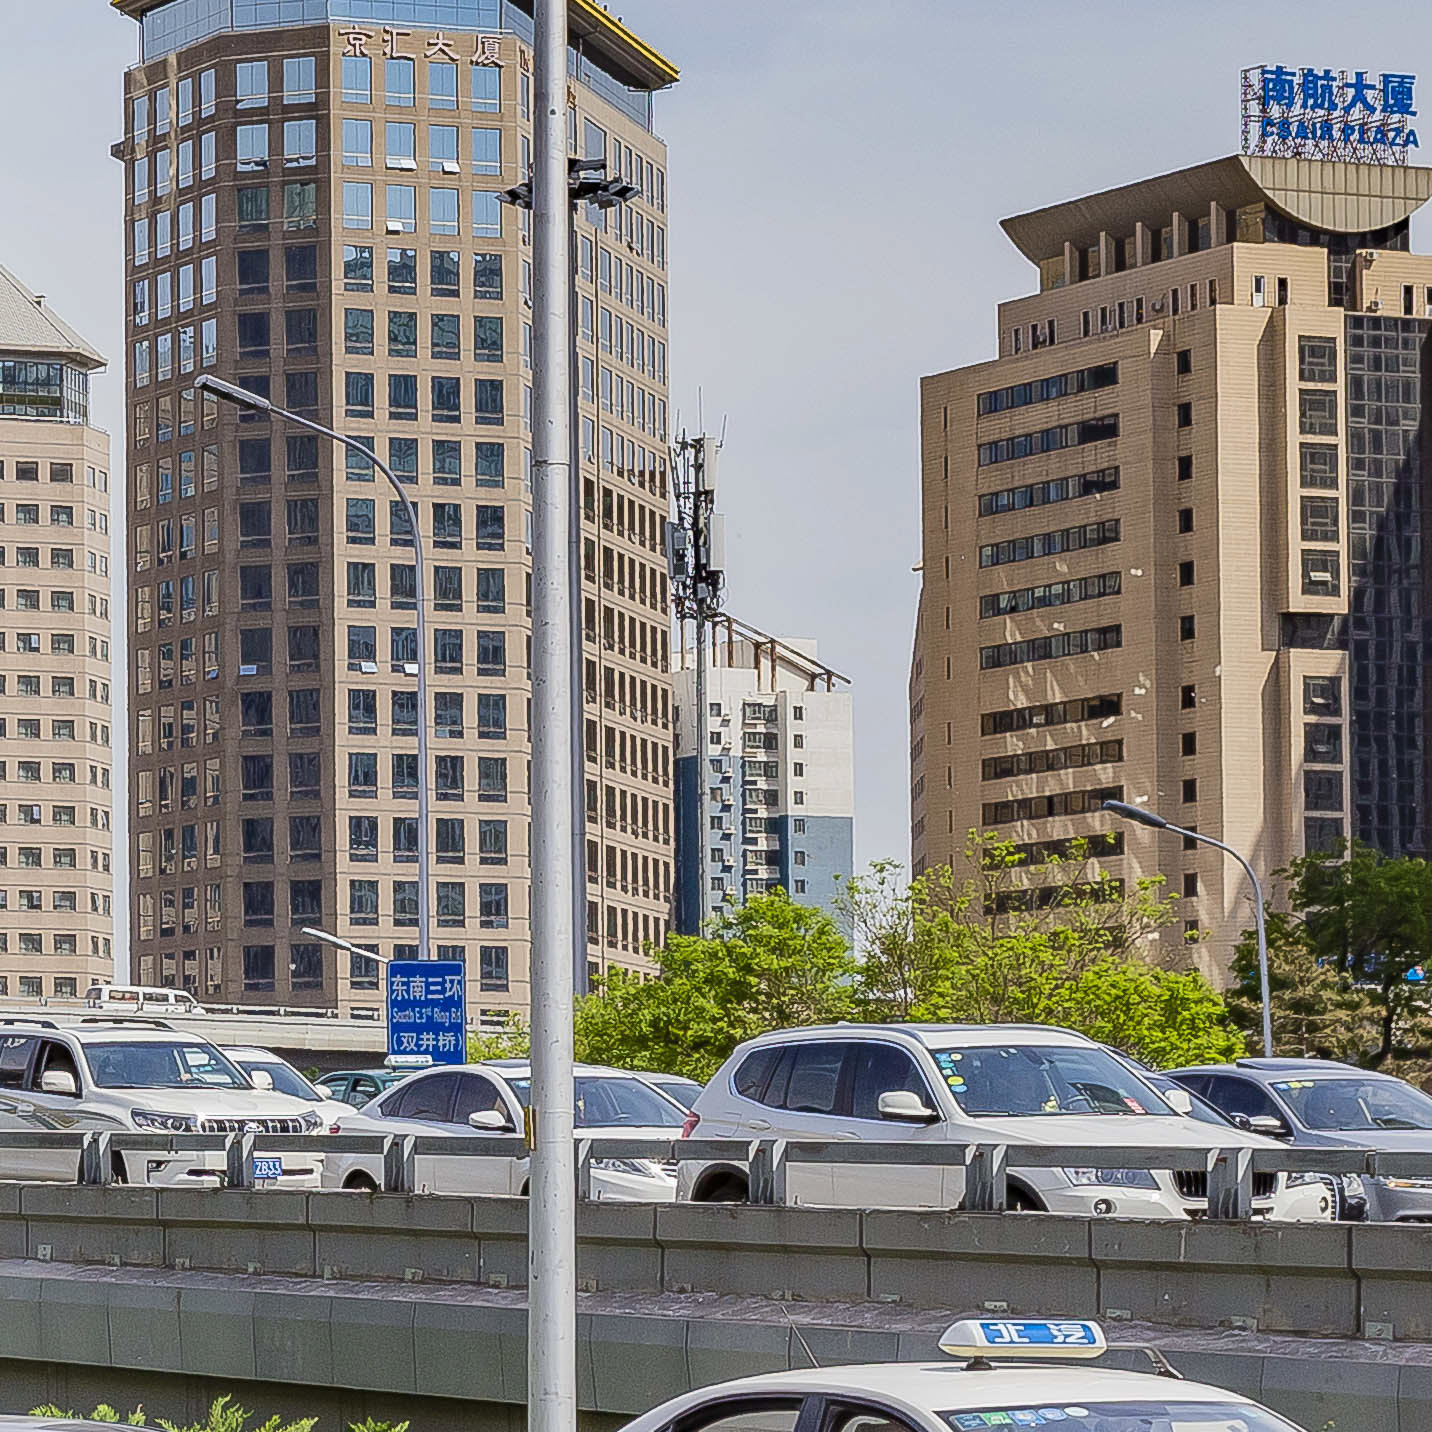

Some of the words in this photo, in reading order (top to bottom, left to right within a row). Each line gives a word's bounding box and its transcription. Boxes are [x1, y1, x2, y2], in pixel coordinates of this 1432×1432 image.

[338, 24, 505, 68] 京汇大厦
[1260, 65, 1418, 117] 南航大厦
[1342, 124, 1420, 149] PLAZA
[391, 974, 462, 1001] 东南三环
[433, 1008, 450, 1027] Ring
[393, 1032, 463, 1052] (双井桥)
